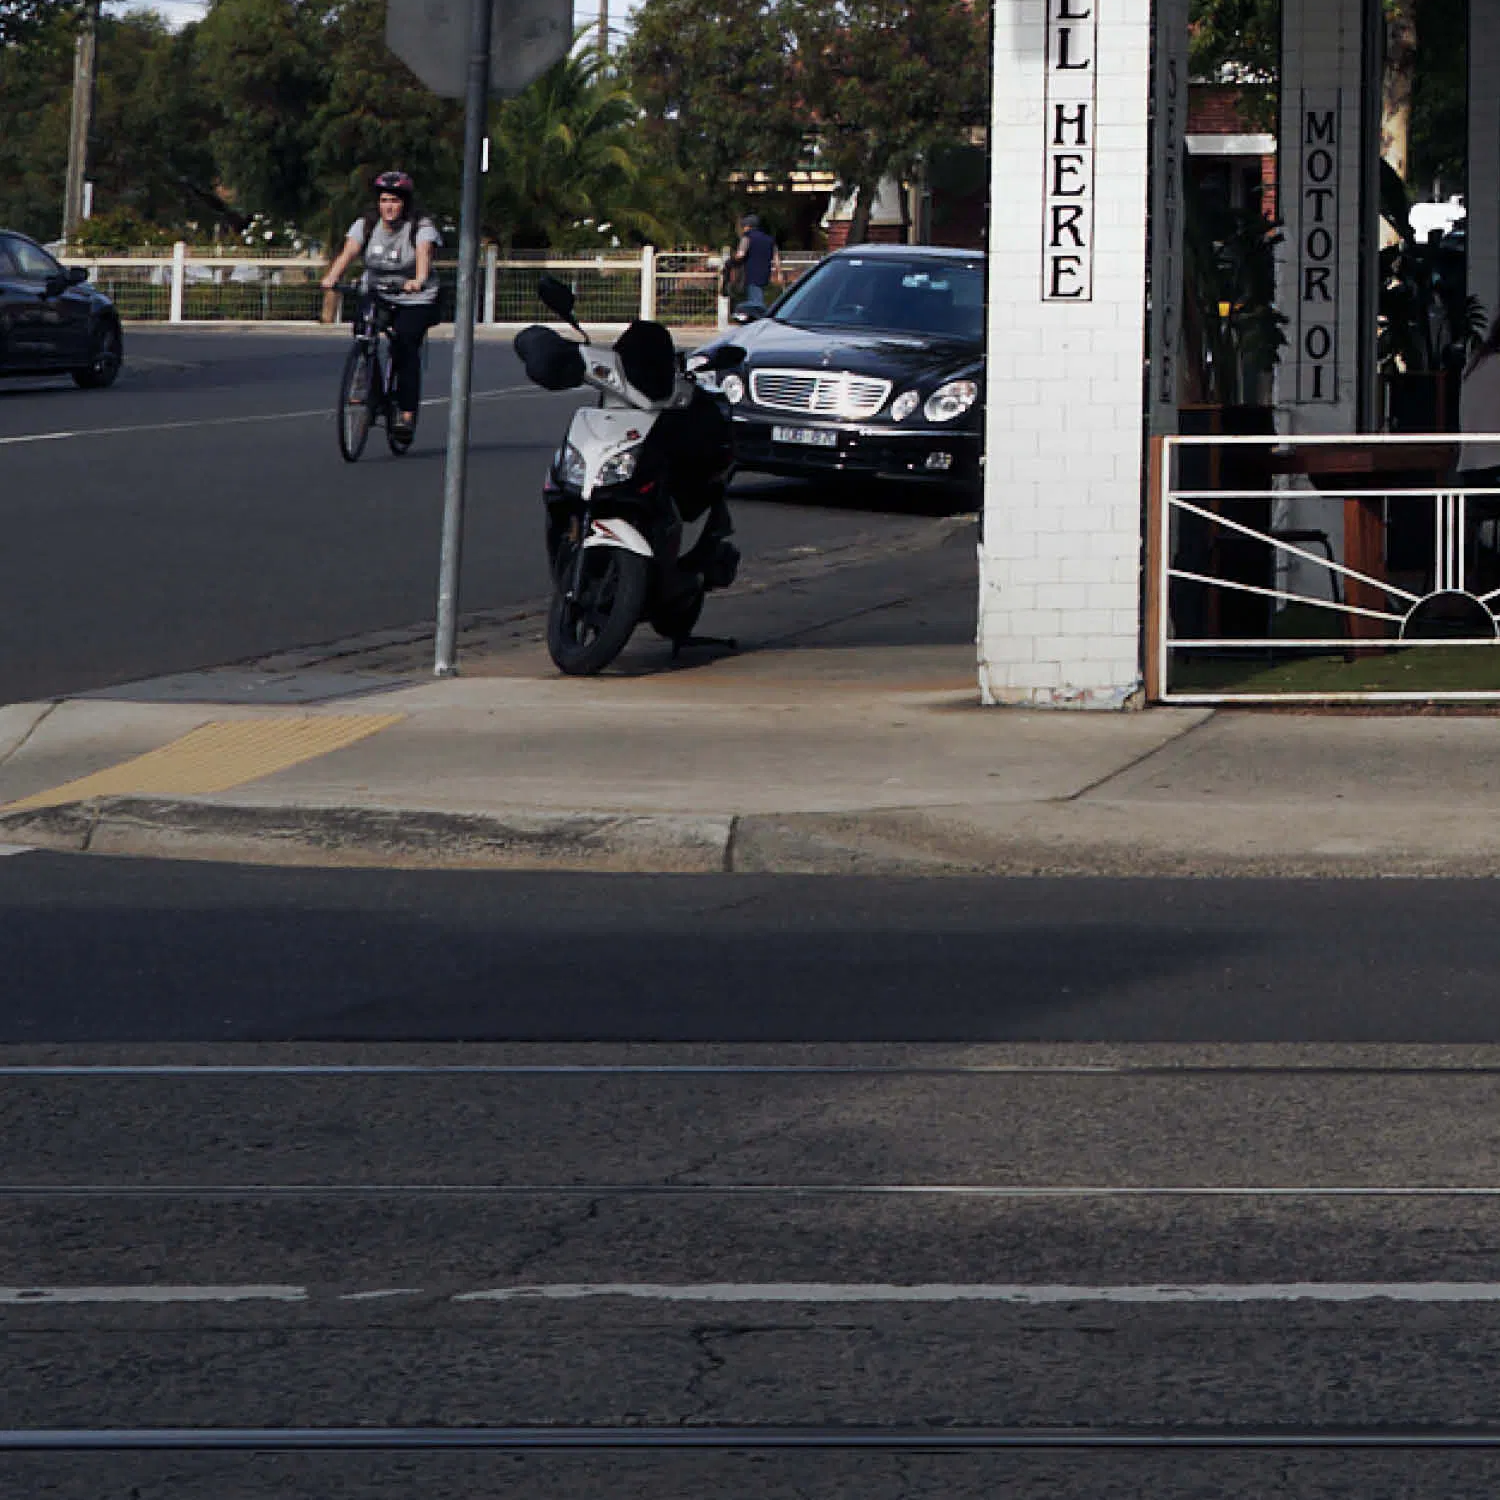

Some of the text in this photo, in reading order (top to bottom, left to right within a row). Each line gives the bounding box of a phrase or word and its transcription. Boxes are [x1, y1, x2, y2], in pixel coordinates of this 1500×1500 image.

[1049, 103, 1087, 299] HERE
[1303, 109, 1338, 398] MOTOR OI
